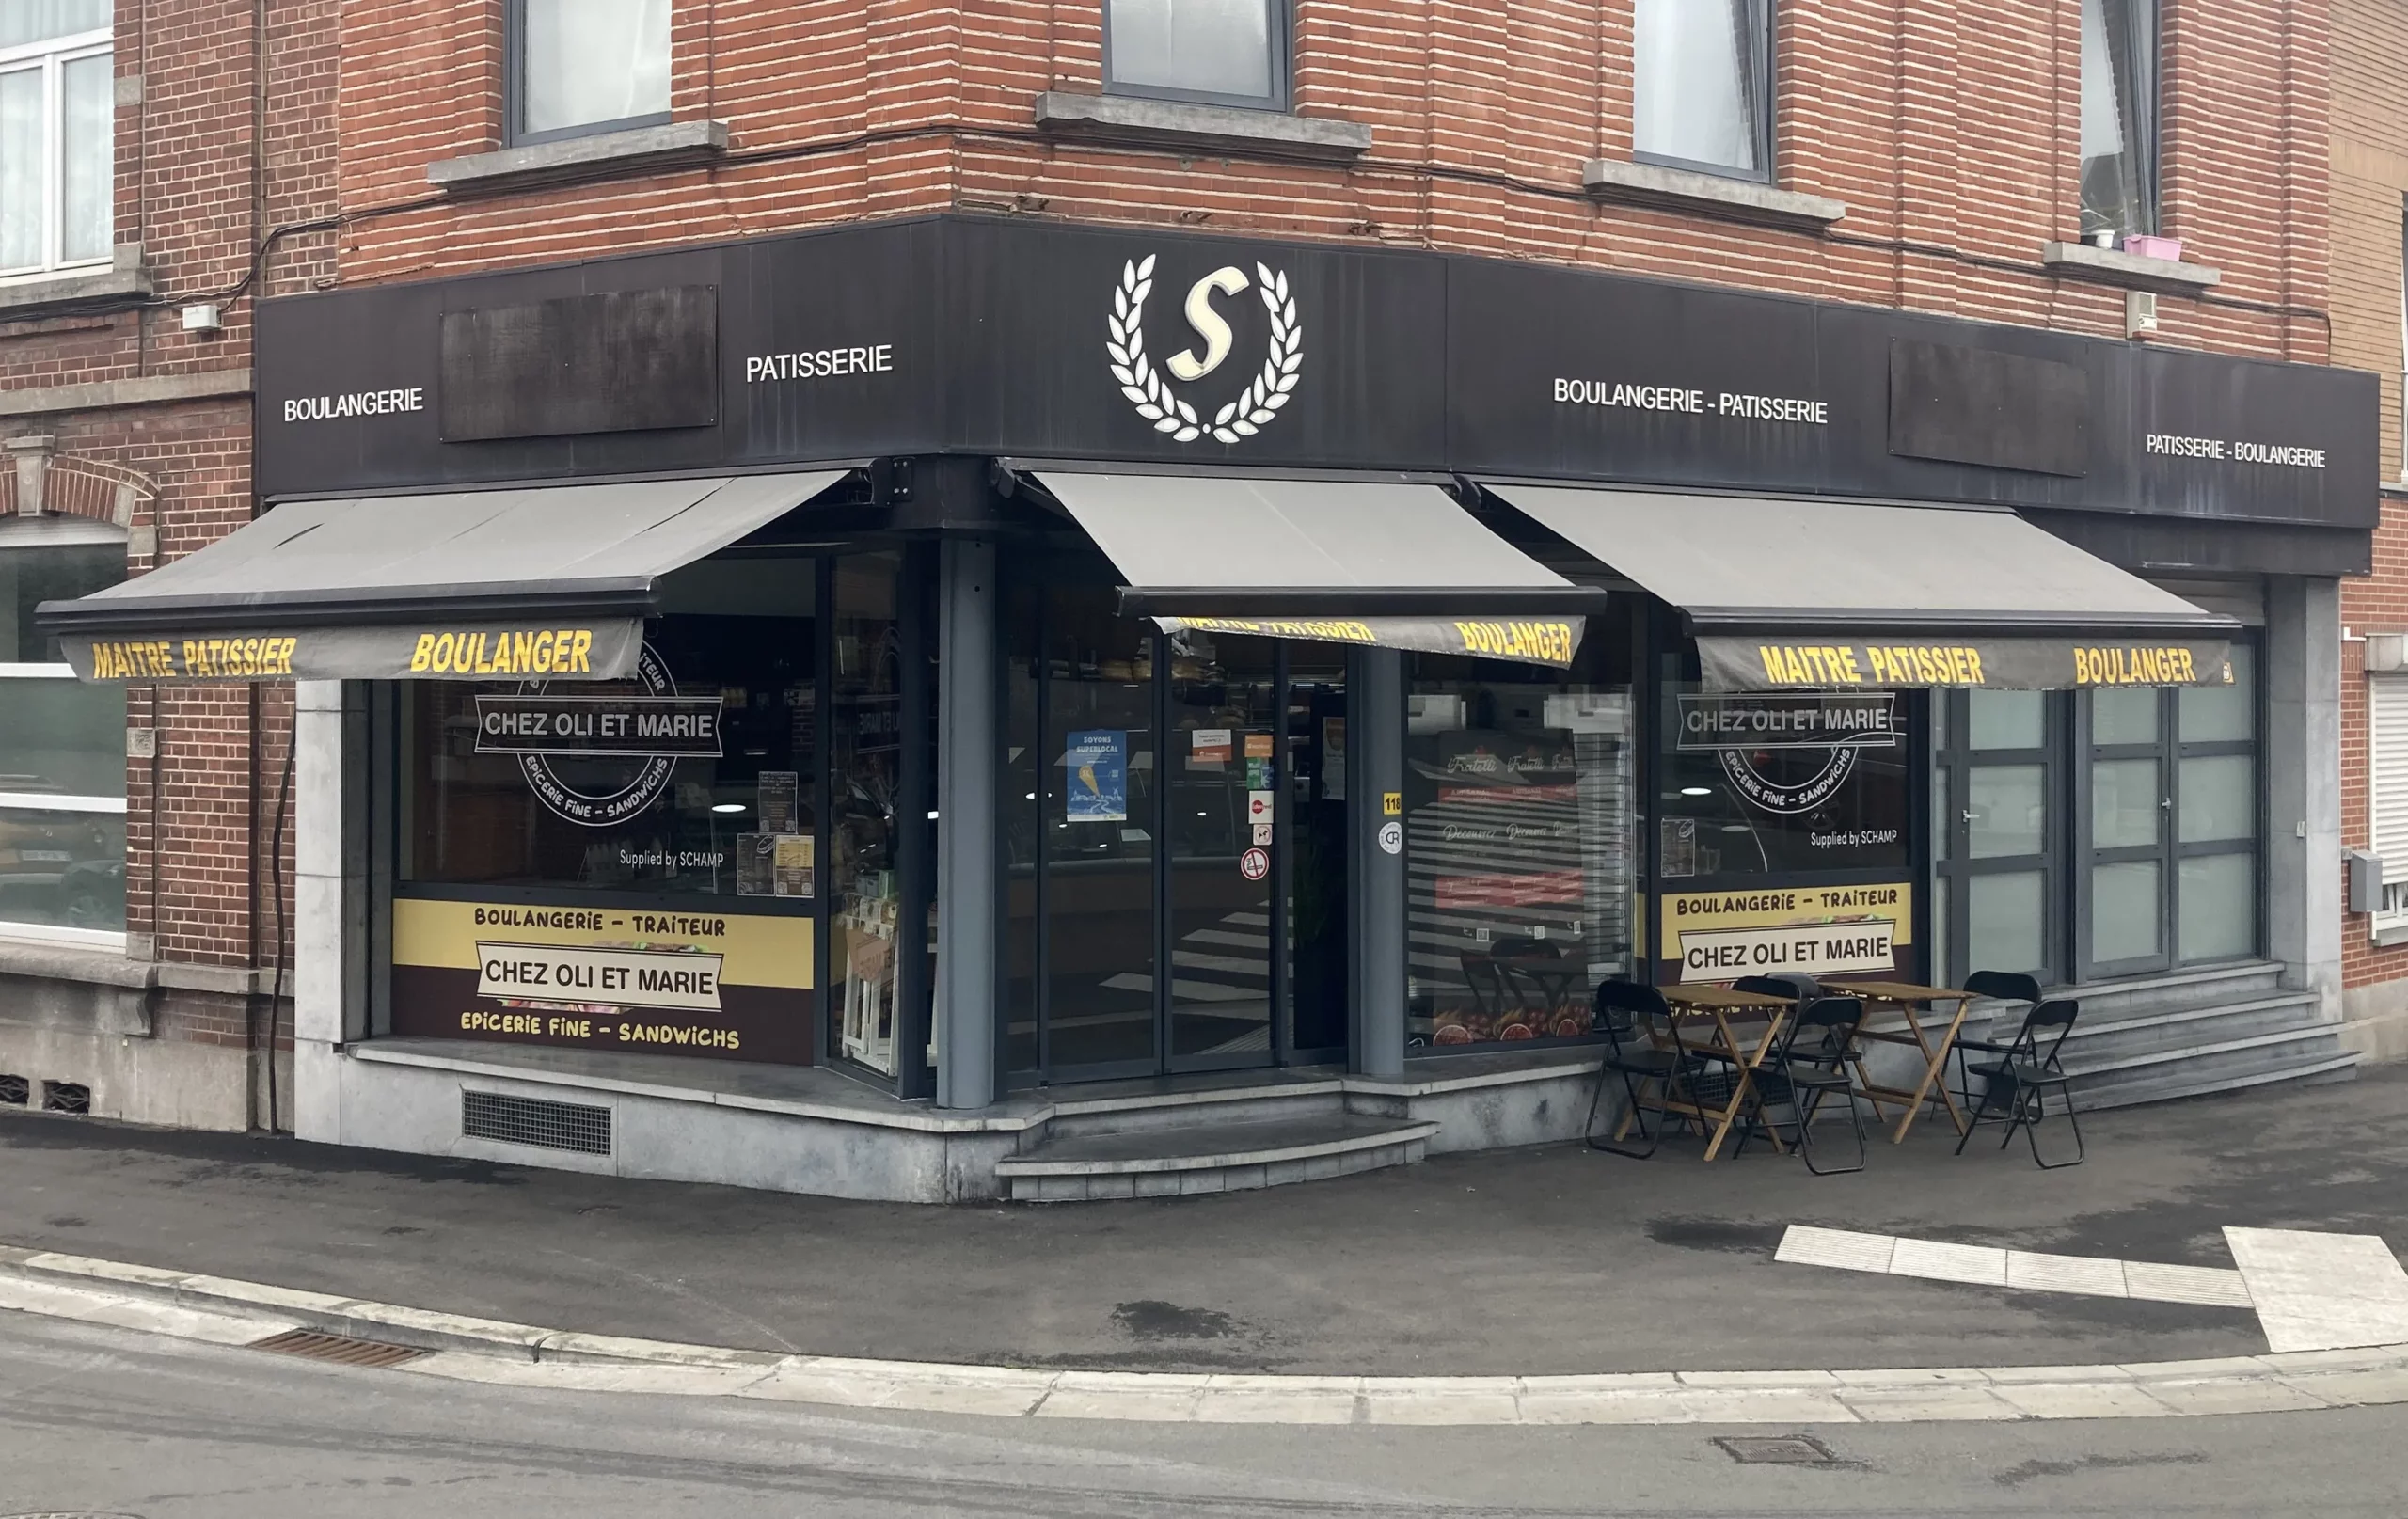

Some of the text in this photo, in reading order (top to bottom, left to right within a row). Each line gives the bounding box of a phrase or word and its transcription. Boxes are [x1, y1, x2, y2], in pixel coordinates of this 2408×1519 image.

[746, 344, 893, 383] PATISSERIE
[284, 387, 423, 422] BOULANGERIE
[1554, 378, 1703, 414] BOULANGERIE
[1719, 392, 1828, 424] PATISSERIE
[2147, 434, 2224, 460] PATISSERIE
[2234, 441, 2326, 468] BOULANGERIE
[92, 637, 296, 678] MAITRE PATISSIER
[410, 630, 592, 673] BOULANGER
[1454, 621, 1572, 662] BOULANGER
[1760, 646, 1984, 683] MAITRE PATISSIER
[2073, 647, 2196, 684] BOULANGER
[484, 712, 713, 737] CHEZ OLI ET MARIE
[1687, 708, 1887, 732] CHEZ OLI ET MARIE
[1385, 797, 1401, 811] 118
[1811, 830, 1897, 848] Supplied by SCHAMP
[620, 849, 724, 870] Supplied by SCHAMP
[1687, 936, 1888, 969] CHEZ OLI ET MARIE
[485, 959, 713, 995] CHEZ OLI ET MARIE
